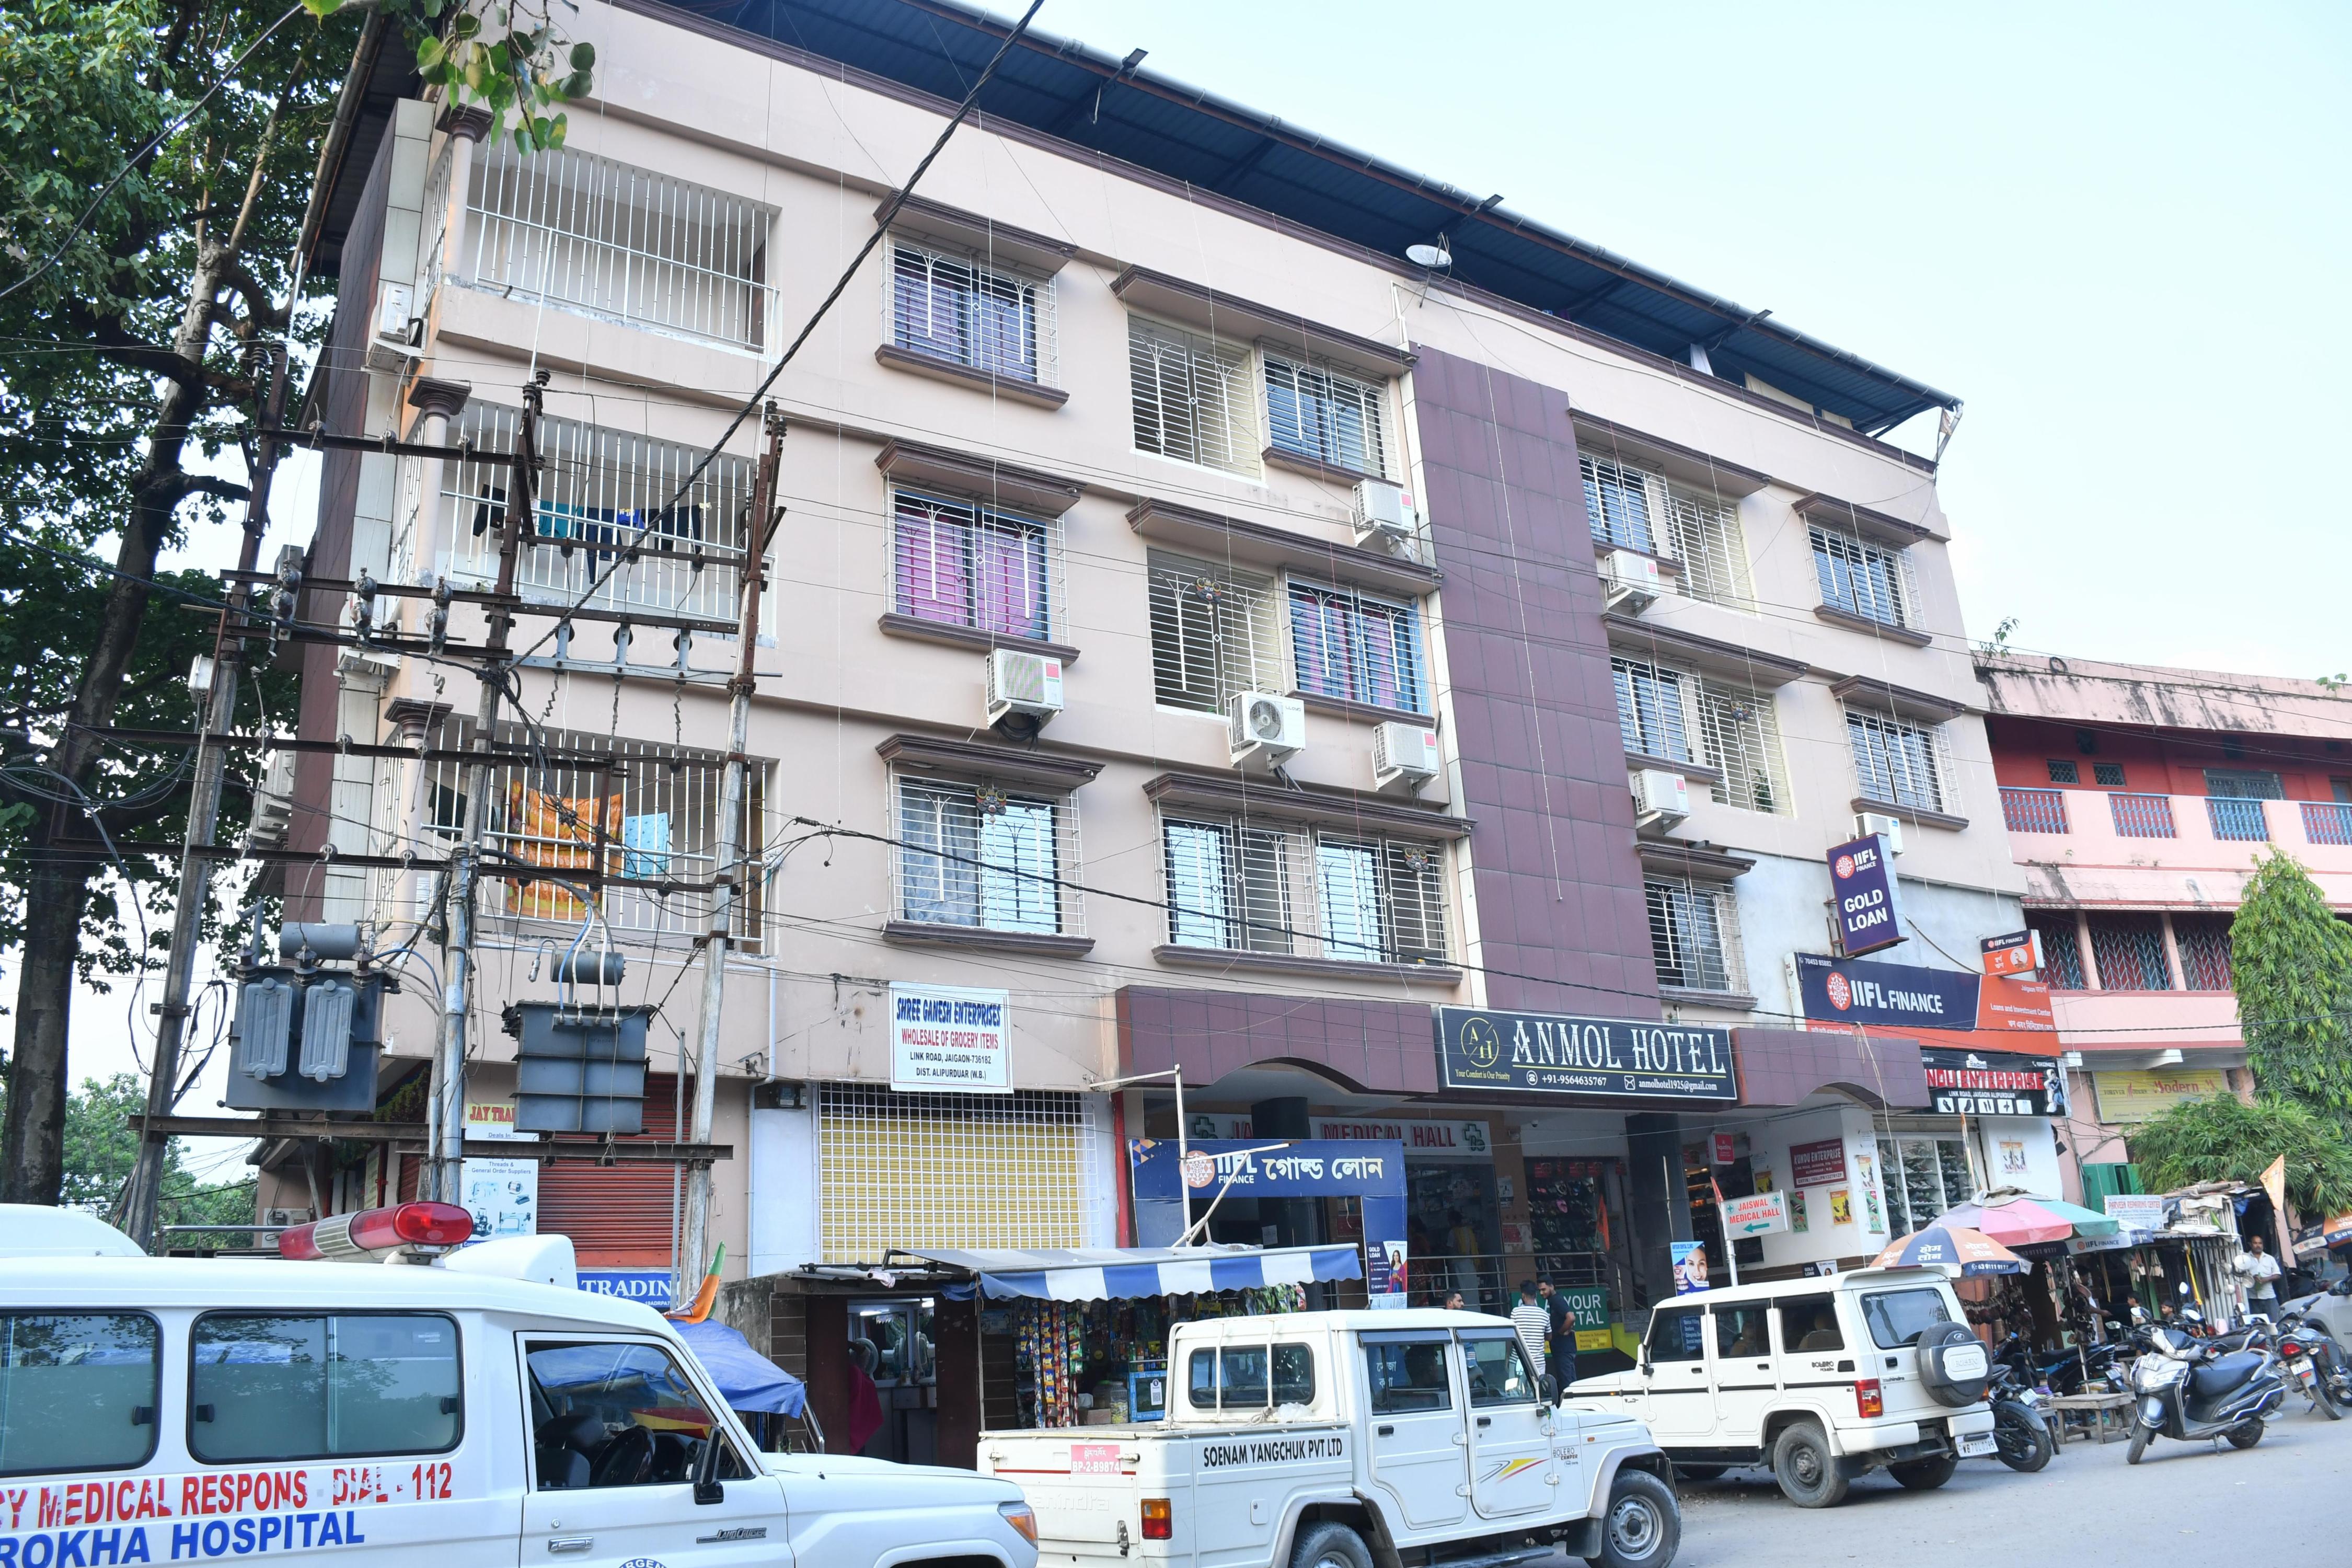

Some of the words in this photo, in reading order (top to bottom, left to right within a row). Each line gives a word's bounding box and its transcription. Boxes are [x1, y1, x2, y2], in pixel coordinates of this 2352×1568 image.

[1853, 848, 1877, 866] IIFL
[1856, 861, 1876, 872] FINANCE
[1844, 889, 1883, 913] GOLD
[1848, 907, 1888, 932] LOAN
[1850, 980, 1888, 1009] IIFL
[1888, 990, 1944, 1014] FINANCE
[896, 997, 921, 1022] SHREE
[923, 999, 952, 1024] GANESH
[954, 1001, 1001, 1027] ENTERPRISES
[1990, 1003, 2004, 1011] Loans
[902, 1028, 939, 1046] WHOLESALE
[941, 1030, 949, 1046] OF
[950, 1031, 978, 1048] GROCERY
[981, 1033, 998, 1050] ITEMS
[1512, 1020, 1622, 1068] ANMOL
[1631, 1029, 1726, 1074] HOTEL
[910, 1052, 924, 1060] LINK
[926, 1053, 943, 1063] ROAD,
[945, 1054, 991, 1064] JAIGAON-736182
[916, 1067, 930, 1076] DIST.
[932, 1069, 969, 1078] ALIPURDUAR
[971, 1070, 986, 1080] (W.B.)
[1455, 1069, 1465, 1077] Your
[1466, 1070, 1483, 1078] Comfort
[1495, 1072, 1511, 1082] Priority
[1542, 1074, 1607, 1086] +91-9564635767
[1924, 1068, 1956, 1088] NDU
[1957, 1070, 2045, 1090] ENTERPRISE
[1639, 1078, 1717, 1093] anmolhotel1925@gmail.com
[469, 1106, 490, 1121] JAY
[1413, 1126, 1456, 1147] HALL
[1794, 1153, 1810, 1165] KUNDU
[1811, 1148, 1841, 1162] ENTERPRISE
[1261, 1157, 1324, 1180] গোল্ড
[1331, 1157, 1384, 1180] লোন
[1218, 1175, 1254, 1184] FINANCE
[1738, 1198, 1768, 1212] JAISWAL
[1730, 1211, 1760, 1224] MEDICAL
[1762, 1208, 1780, 1218] HALL
[581, 1279, 679, 1296] TRADIN
[1563, 1294, 1601, 1310] YOUR
[1203, 1444, 1248, 1468] SOENAM
[1250, 1440, 1306, 1463] YANGCHUK
[1308, 1438, 1327, 1458] PVT
[1328, 1438, 1343, 1457] LTD
[1553, 1447, 1574, 1457] BOLERO
[1072, 1461, 1120, 1472] BP-2-B9874
[38, 1478, 172, 1528] MEDICAL
[412, 1462, 452, 1500] 112
[171, 1511, 365, 1560] HOSPITAL
